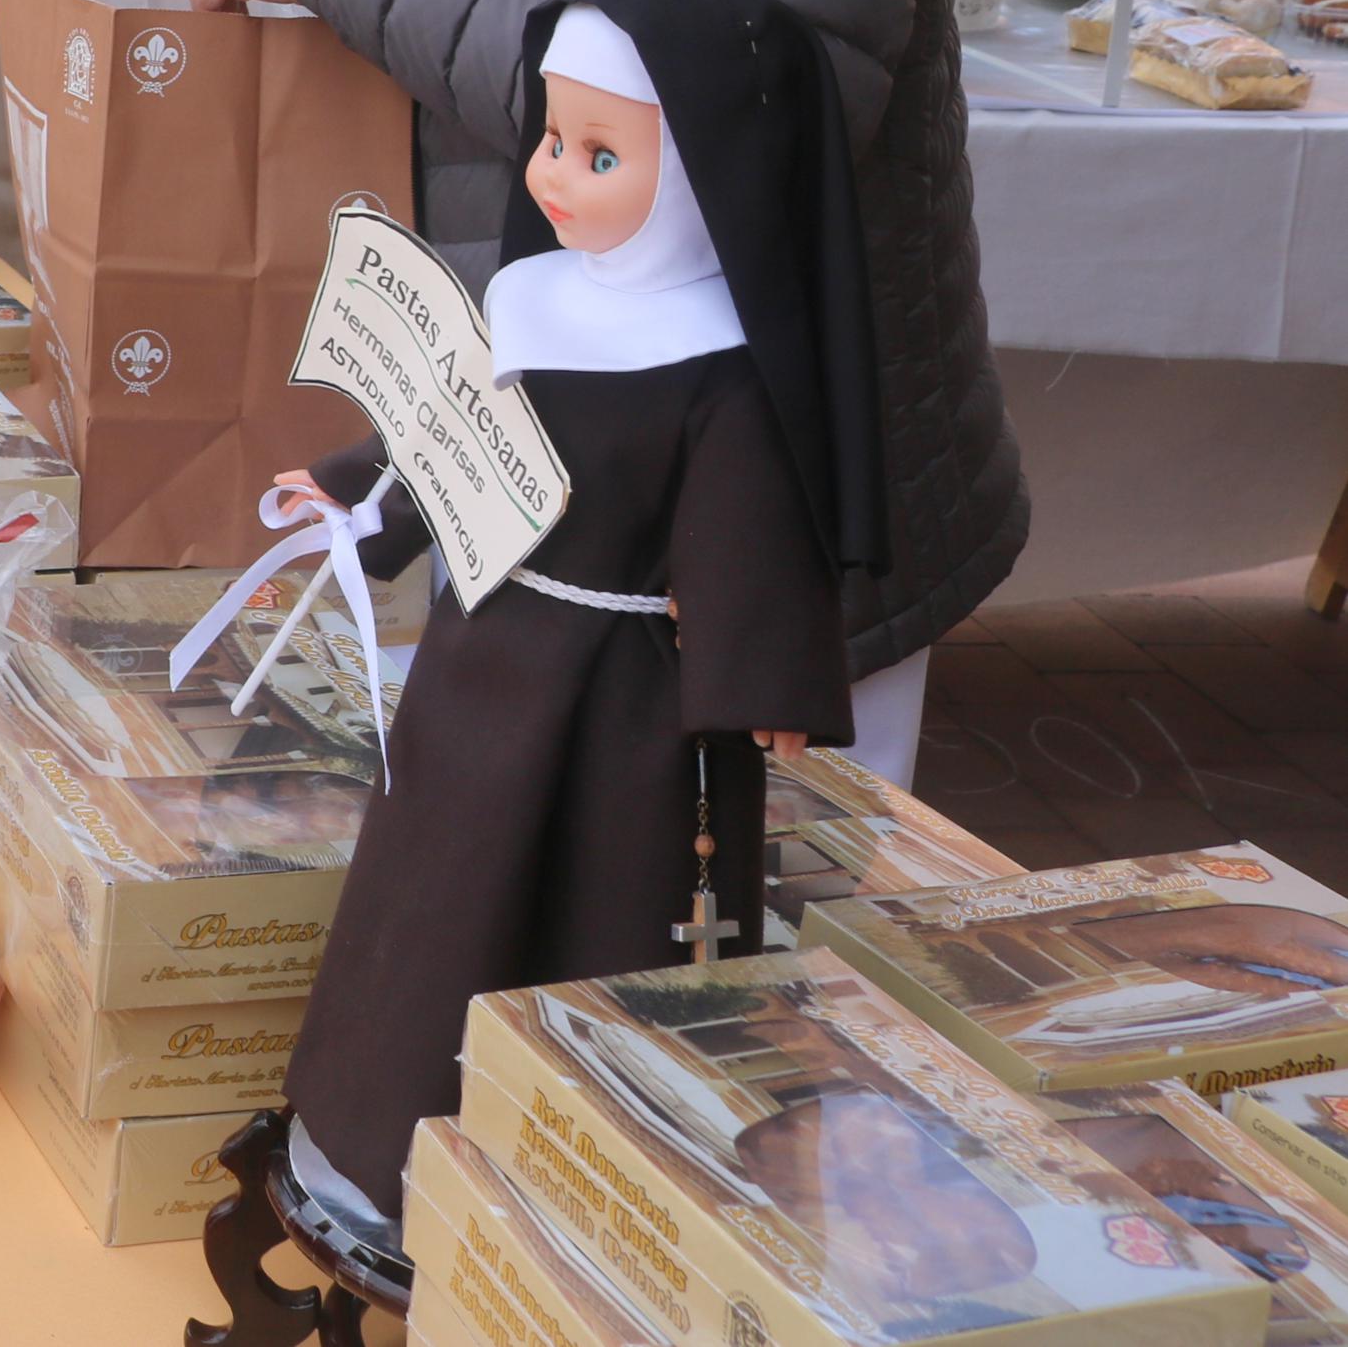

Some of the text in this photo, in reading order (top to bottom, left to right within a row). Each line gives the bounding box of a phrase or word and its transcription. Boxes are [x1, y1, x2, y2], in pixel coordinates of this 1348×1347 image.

[333, 297, 487, 494] Hermanas Clarisas
[355, 245, 549, 513] Pastas Artesanas
[320, 337, 485, 582] ASTUDILLO (Palencia)
[173, 912, 325, 950] Pastas
[161, 1023, 298, 1060] Pastas
[520, 1112, 688, 1293] Hermanas Clarisas
[533, 1086, 680, 1246] Real Monasterio
[1252, 1118, 1347, 1186] Conservar en sitio
[456, 1238, 527, 1343] Hermanas
[466, 1212, 501, 1274] Real
[513, 1144, 595, 1240] Astudillo
[600, 1229, 692, 1336] (Palencia)
